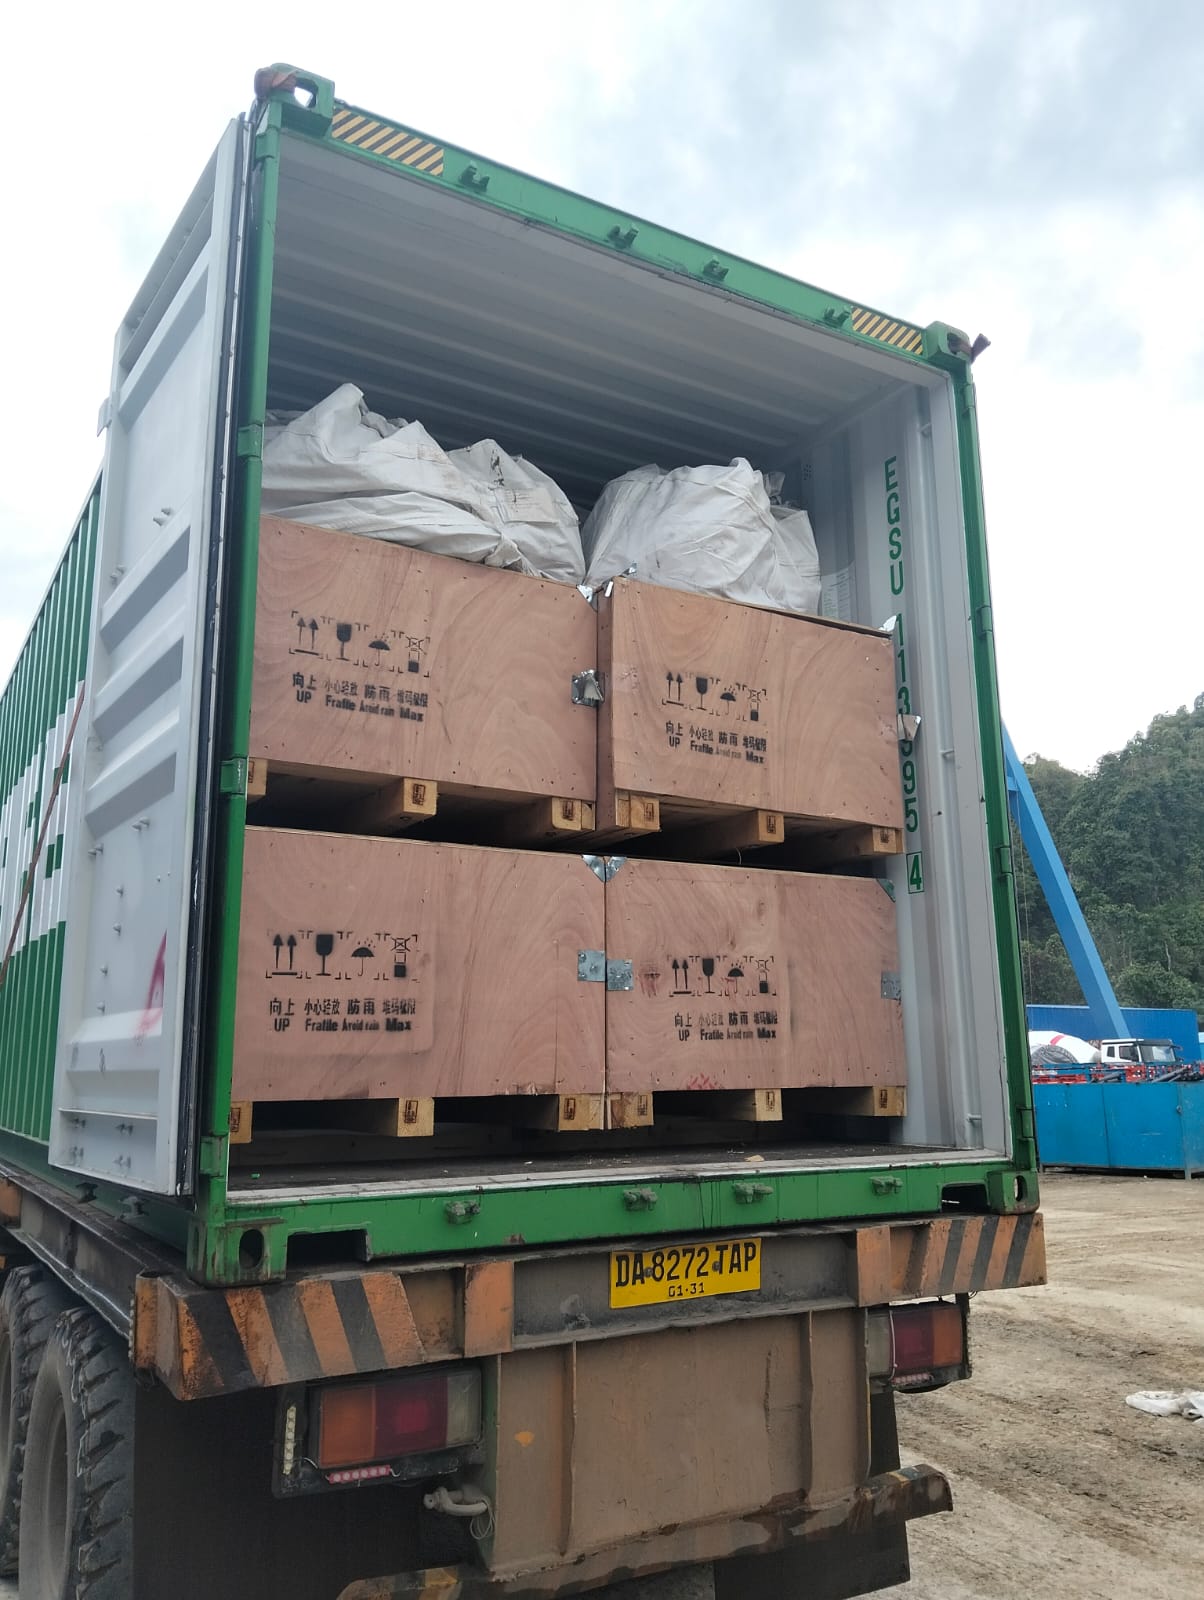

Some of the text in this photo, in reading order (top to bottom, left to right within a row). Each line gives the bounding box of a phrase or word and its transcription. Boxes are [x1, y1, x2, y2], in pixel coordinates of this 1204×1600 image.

[884, 455, 905, 596] EGSU
[909, 854, 922, 891] 4
[296, 689, 312, 703] UP
[399, 706, 424, 722] Max
[669, 735, 681, 749] UP
[745, 750, 764, 764] Max
[270, 997, 295, 1016] 向上
[347, 998, 375, 1015] 防雨
[274, 1018, 290, 1032] UP
[385, 1018, 411, 1032] Max
[675, 1012, 692, 1027] 向上
[678, 1029, 690, 1041] UP
[757, 1026, 776, 1039] Max
[616, 1242, 757, 1287] DA 8272 TAP
